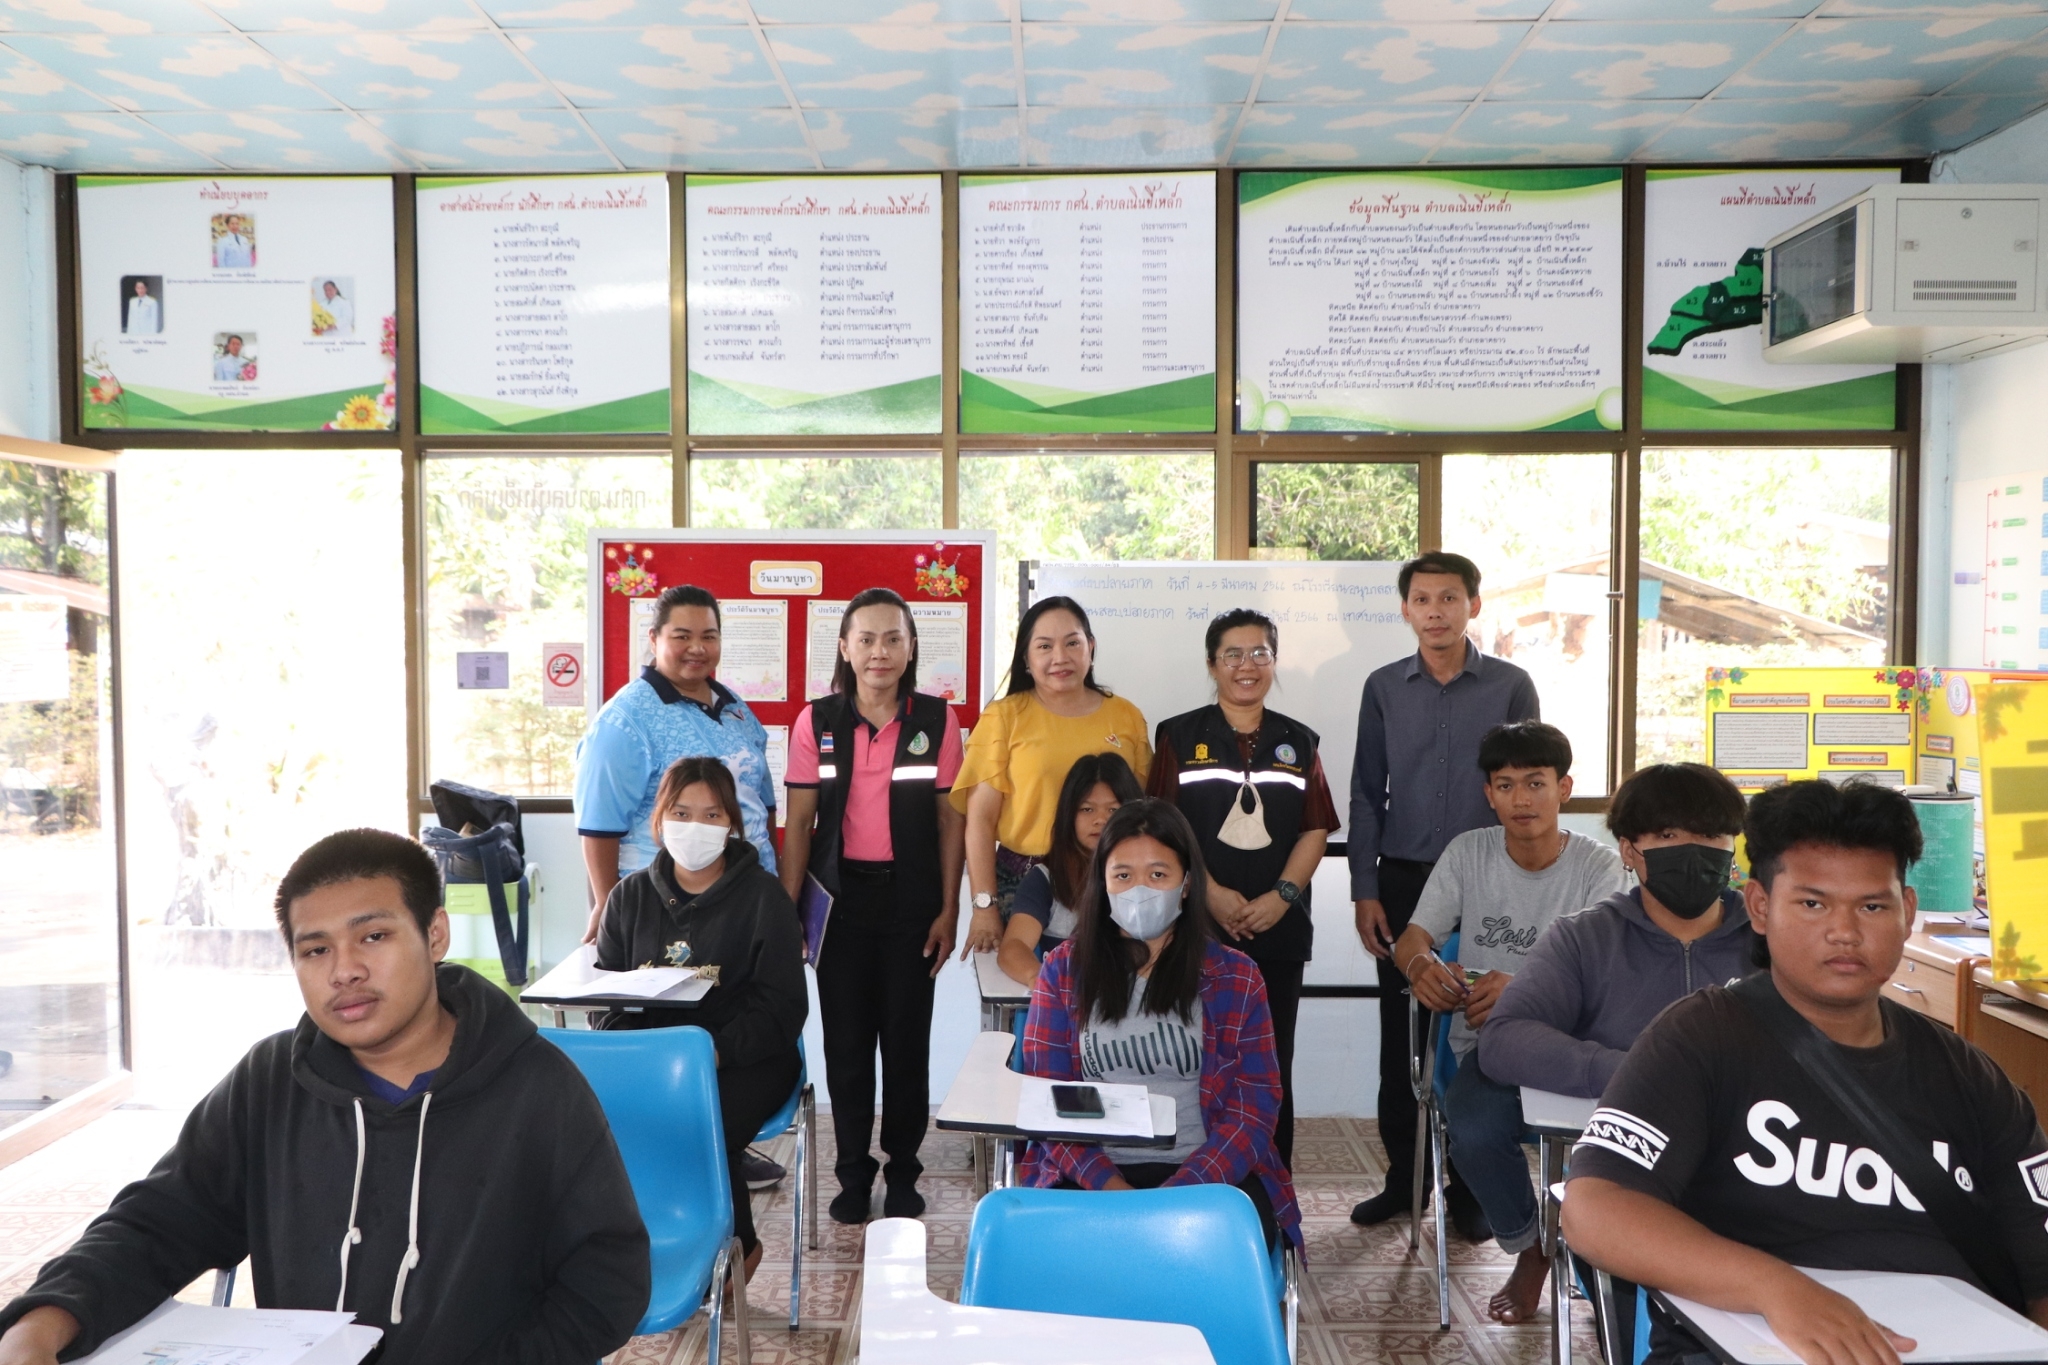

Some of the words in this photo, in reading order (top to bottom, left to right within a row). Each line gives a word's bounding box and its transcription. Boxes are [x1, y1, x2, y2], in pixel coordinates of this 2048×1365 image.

[988, 199, 1061, 212] คณะกรรมการ
[1349, 192, 1420, 223] ข้อมูลพื้นฐาน
[820, 232, 844, 242] ตำแหน่ง
[846, 233, 870, 241] ประธาน
[820, 247, 844, 256] ตำแหน่ง
[820, 262, 844, 271] ตำแหน่ง
[846, 261, 887, 271] ประชาสัมพันธ์
[820, 277, 844, 286] ตำแหน่ง
[820, 292, 844, 301] ตำแหน่ง
[820, 306, 844, 316] ตำแหน่ง
[820, 336, 844, 345] ตำแหน่ง
[820, 351, 845, 360] ตำแหน่ง
[760, 572, 813, 586] วันมาฆบูชา
[1474, 915, 1537, 948] Lost
